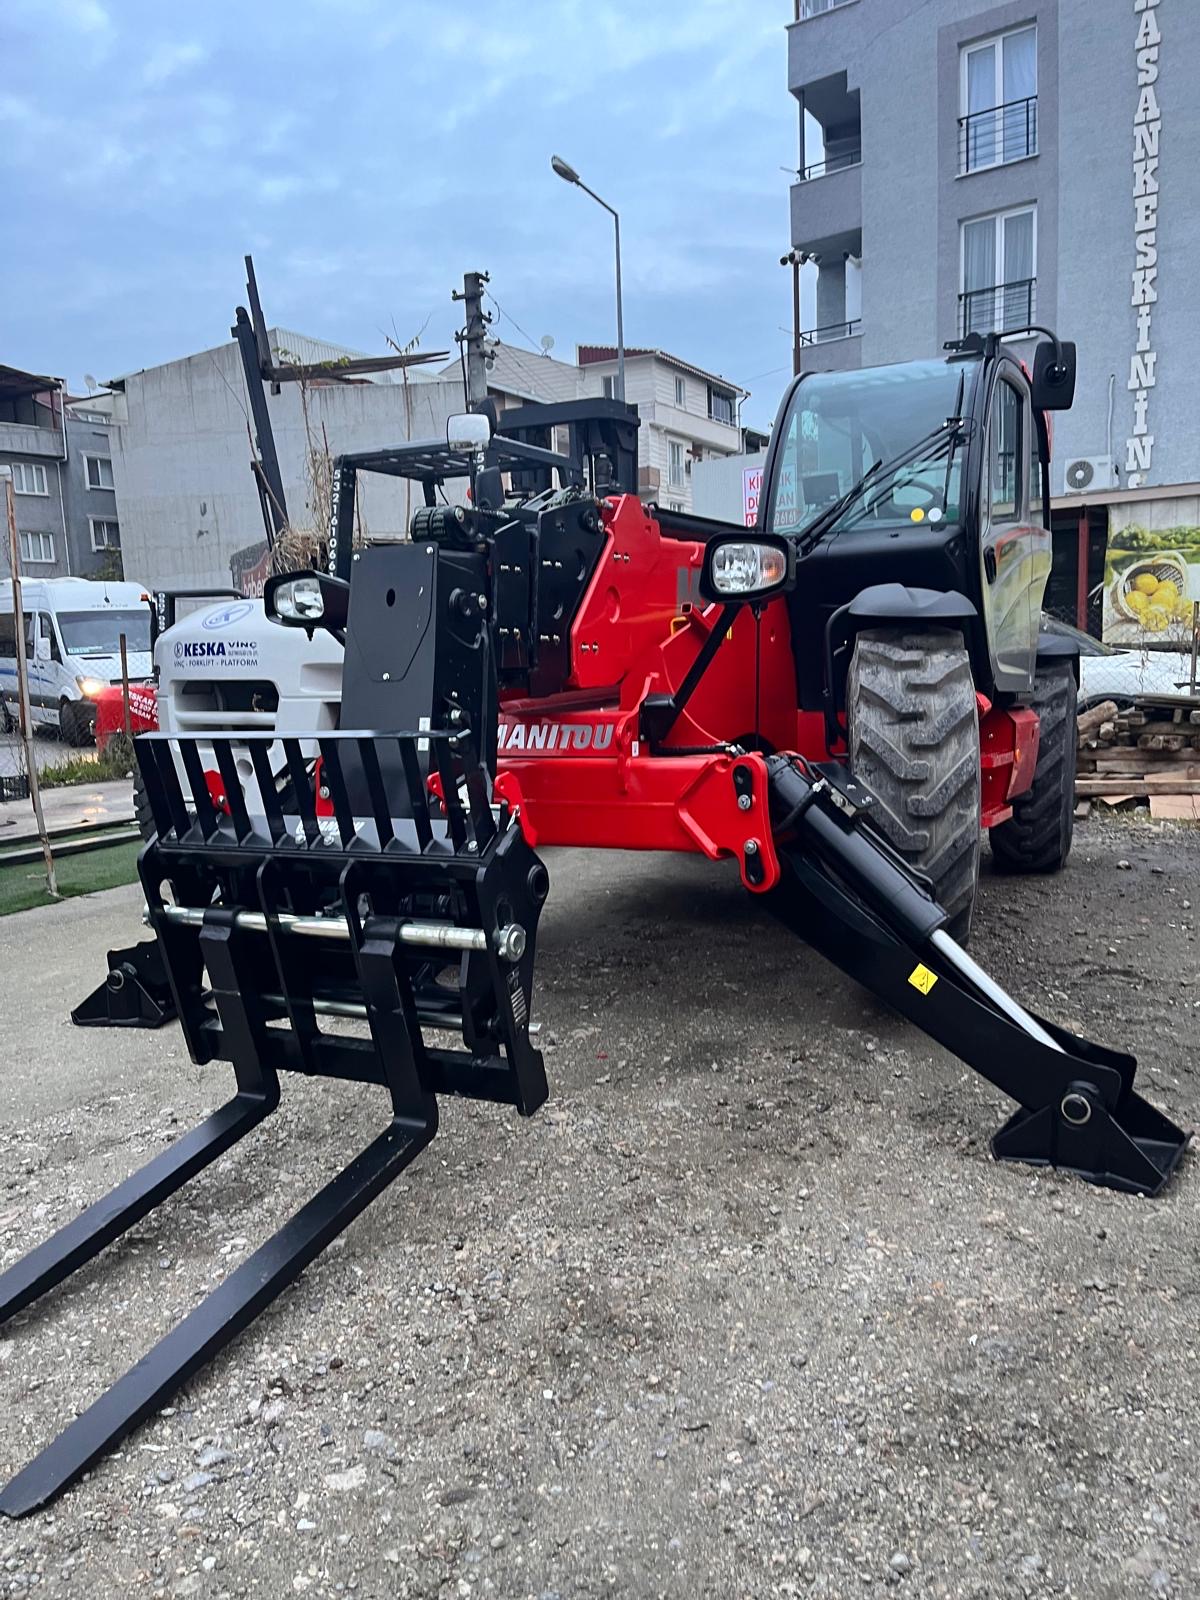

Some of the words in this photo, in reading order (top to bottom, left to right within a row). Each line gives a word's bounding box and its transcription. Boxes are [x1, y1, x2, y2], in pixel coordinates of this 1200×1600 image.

[184, 642, 226, 657] KESKA
[227, 640, 258, 650] VİNÇ
[220, 658, 258, 667] PLATFORM
